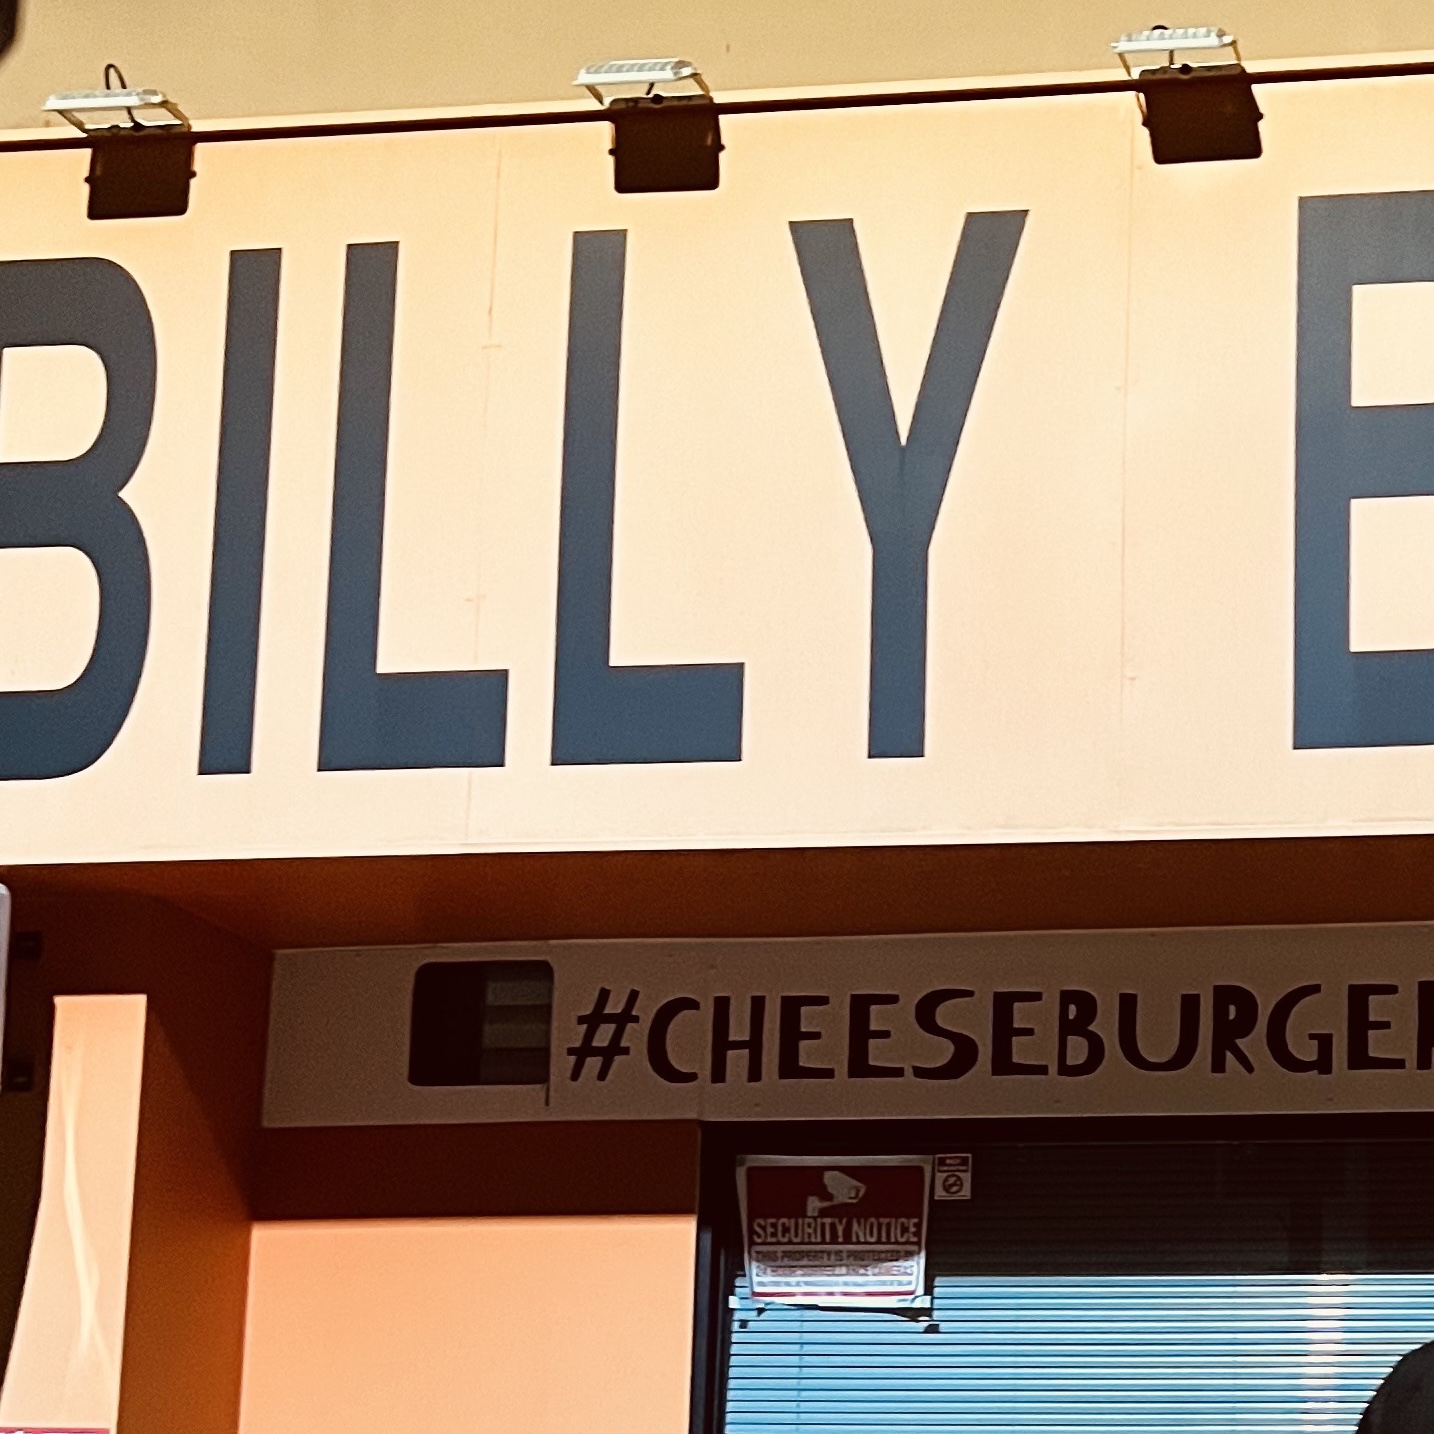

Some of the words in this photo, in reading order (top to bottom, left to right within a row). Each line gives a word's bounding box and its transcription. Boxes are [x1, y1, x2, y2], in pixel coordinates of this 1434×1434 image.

[0, 208, 1030, 781] BILLY
[753, 1218, 848, 1243] SECURITY
[851, 1217, 919, 1243] NOTICE
